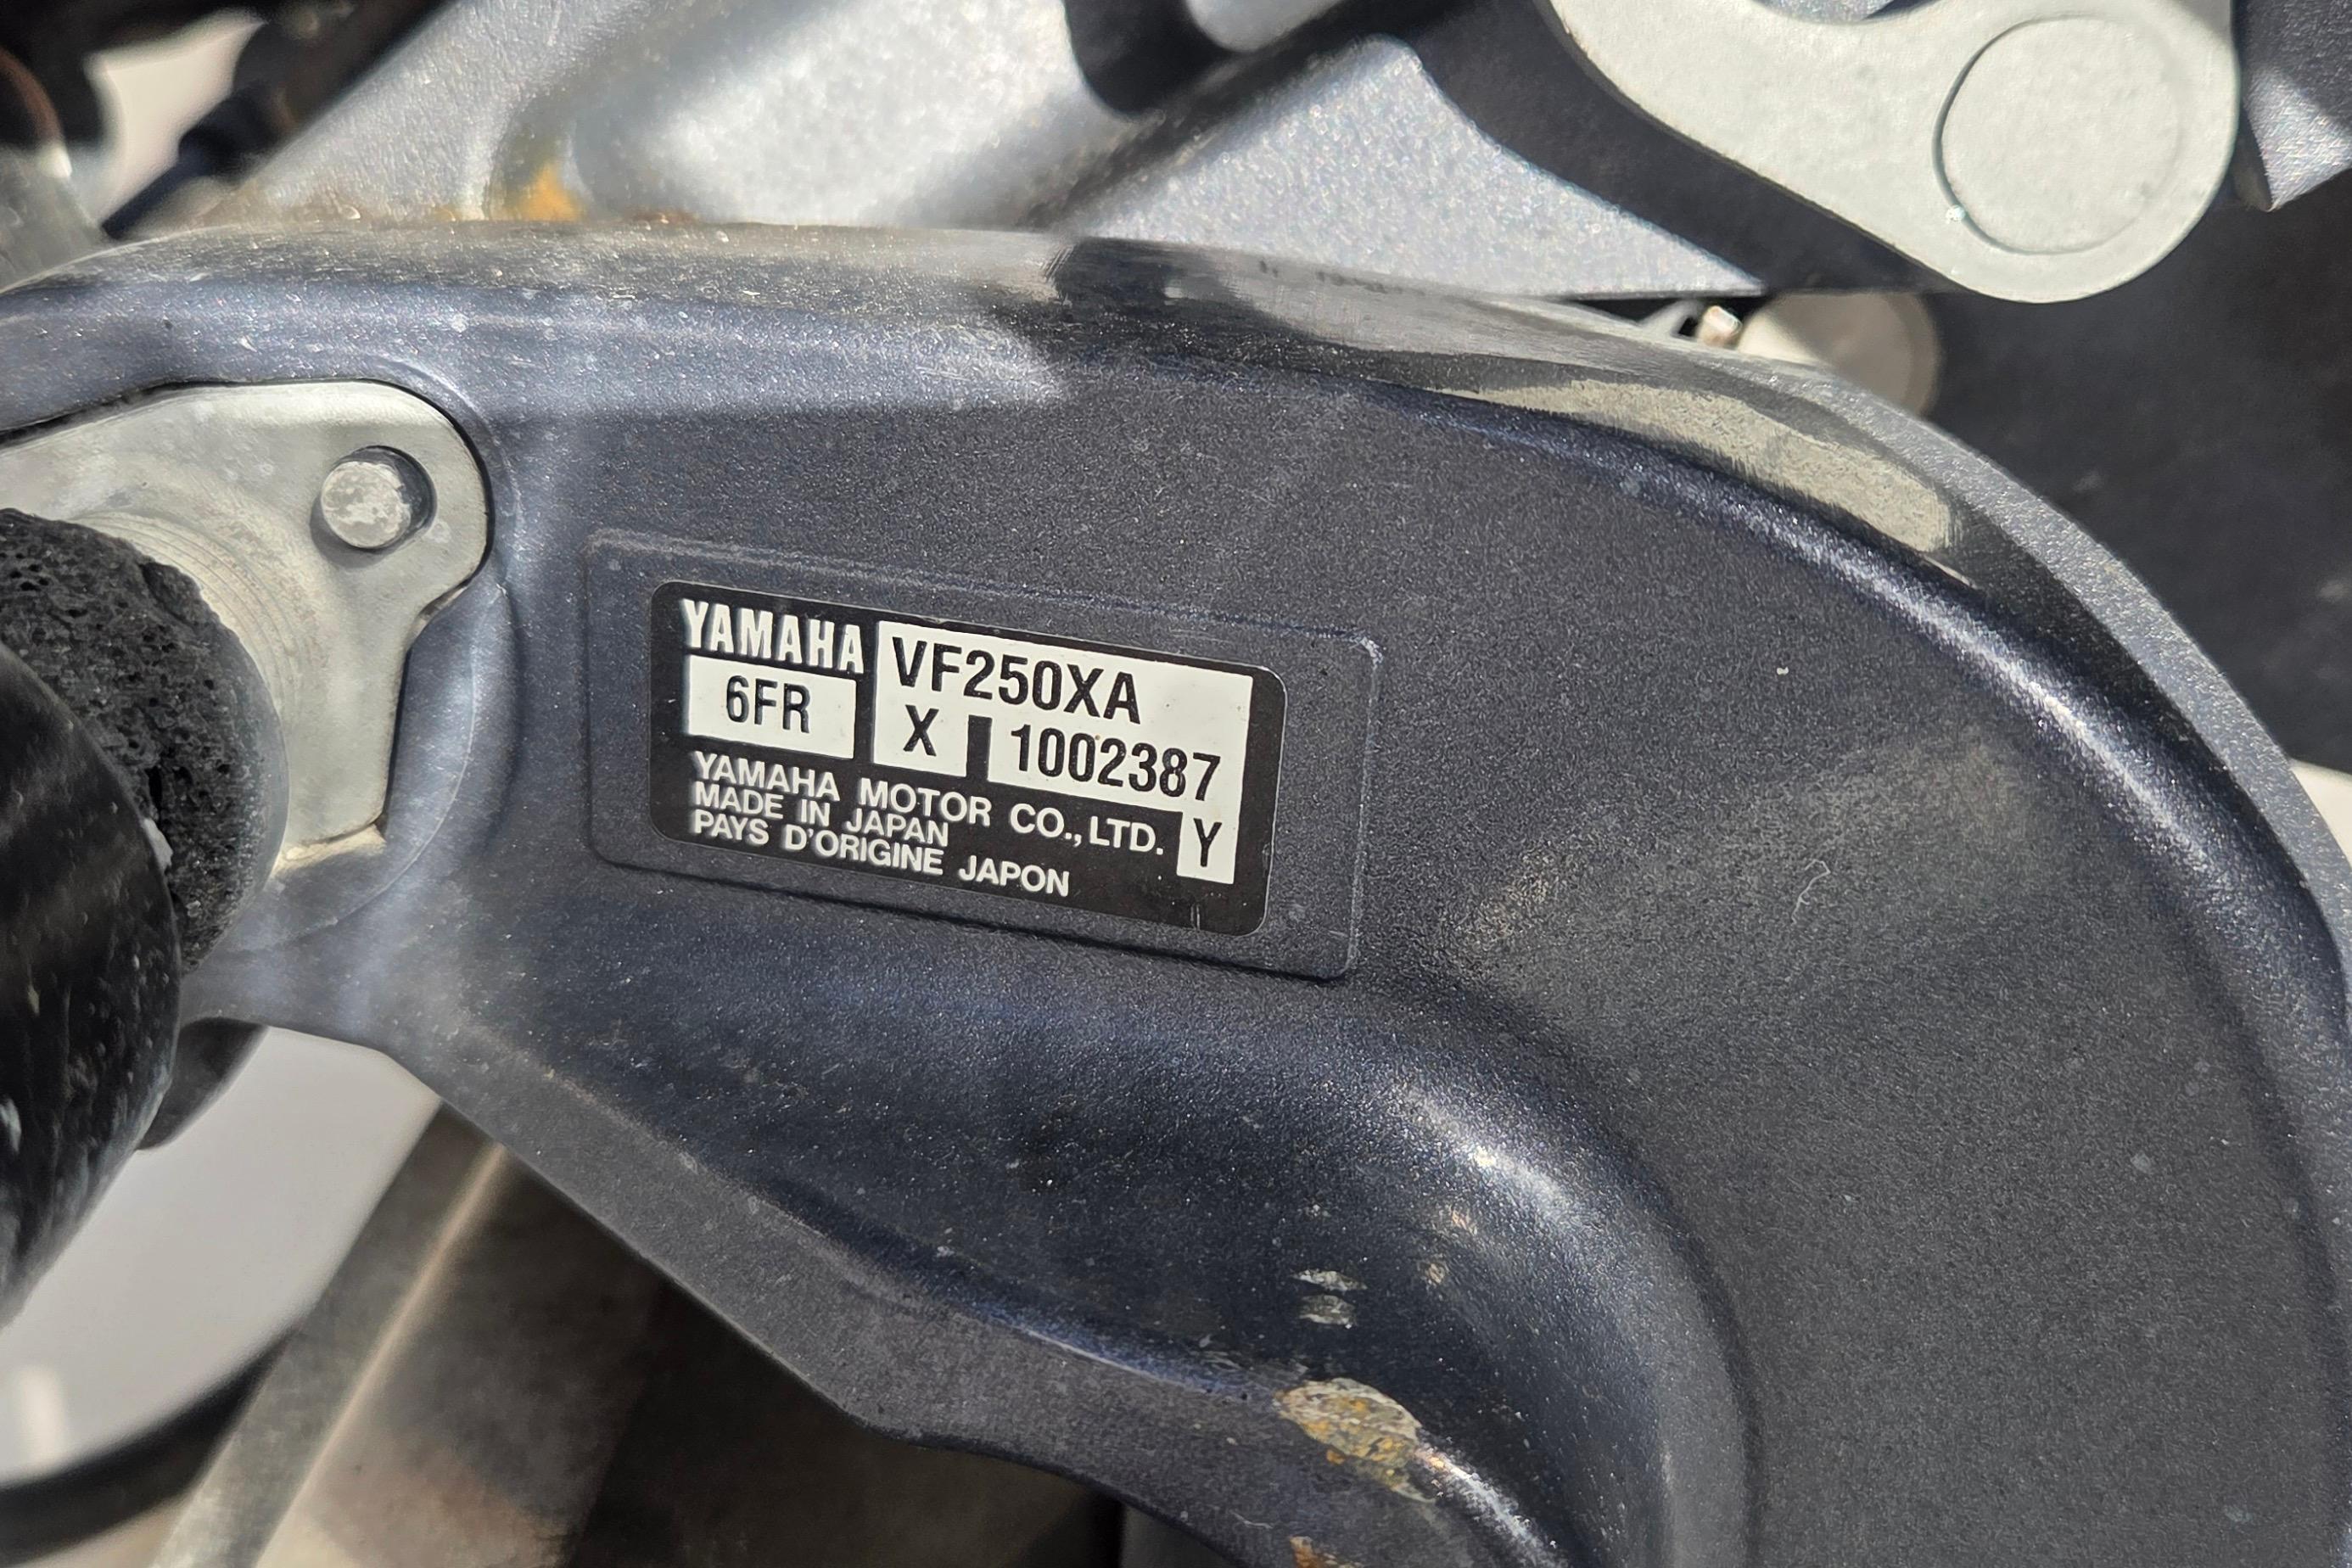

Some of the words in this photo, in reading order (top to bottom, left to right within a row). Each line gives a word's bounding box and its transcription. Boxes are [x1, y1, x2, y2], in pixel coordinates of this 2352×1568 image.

[683, 597, 864, 674] YAMAHA
[725, 675, 810, 734] 6FR
[891, 636, 1141, 725] VF250XA
[692, 751, 839, 802] YAMAHA
[859, 778, 992, 826] MOTOR
[904, 703, 939, 757] X
[1011, 723, 1222, 802] 1002387
[692, 780, 783, 820] MADE
[801, 798, 829, 826] IN
[847, 804, 949, 847] JAPAN
[1193, 817, 1222, 868] Y
[692, 808, 768, 846] PAYS
[784, 822, 944, 876] D'ORIGINE
[958, 854, 1070, 898] JAPON
